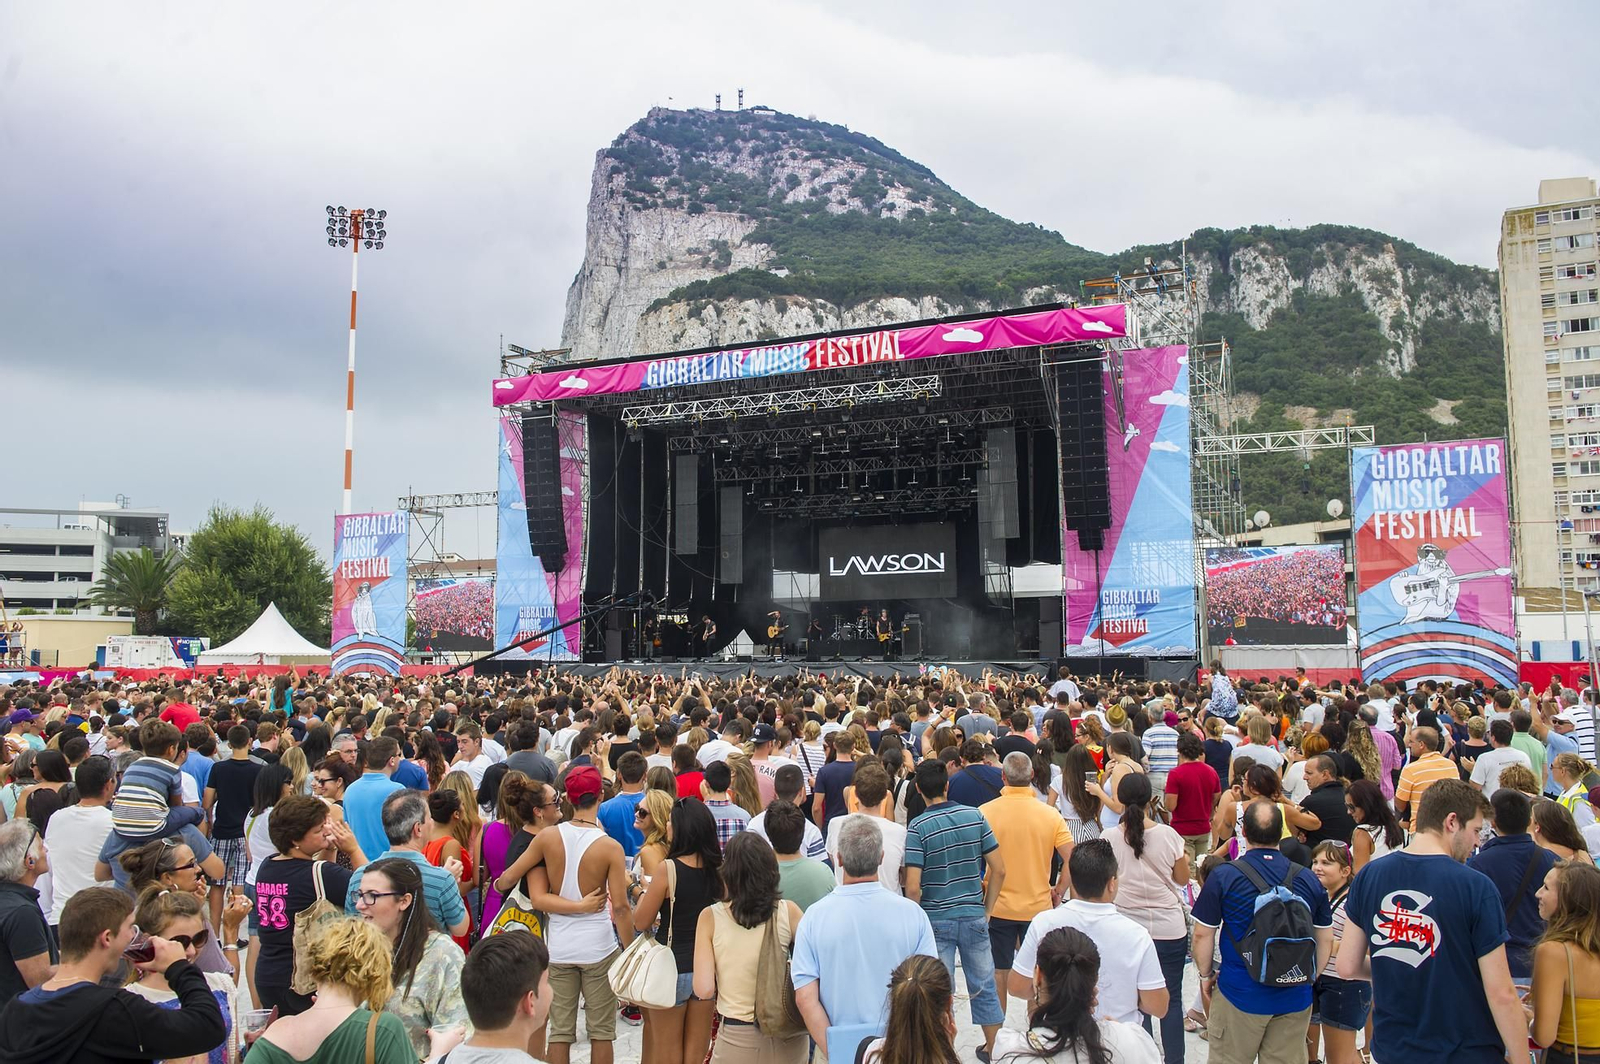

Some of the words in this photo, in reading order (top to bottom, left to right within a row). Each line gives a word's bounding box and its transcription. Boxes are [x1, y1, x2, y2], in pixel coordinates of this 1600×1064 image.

[647, 350, 743, 387] GIBRALTAR
[749, 342, 811, 376] MUSIC
[816, 330, 905, 367] FESTIVAL
[1371, 443, 1501, 480] GIBRALTAR
[1372, 477, 1449, 510] MUSIC
[343, 512, 405, 538] GIBRALTAR
[1374, 506, 1483, 540] FESTIVAL
[342, 536, 378, 558] MUSIC
[342, 556, 393, 579] FESTIVAL
[829, 552, 945, 576] LAWSON
[1102, 589, 1160, 604] GIBRALTAR
[1103, 604, 1137, 618] MUSIC
[519, 617, 542, 630] MUSIC
[1103, 618, 1150, 634] FESTIVAL
[256, 882, 289, 896] GARAGE
[257, 894, 290, 930] 58
[1275, 975, 1308, 984] adidas
